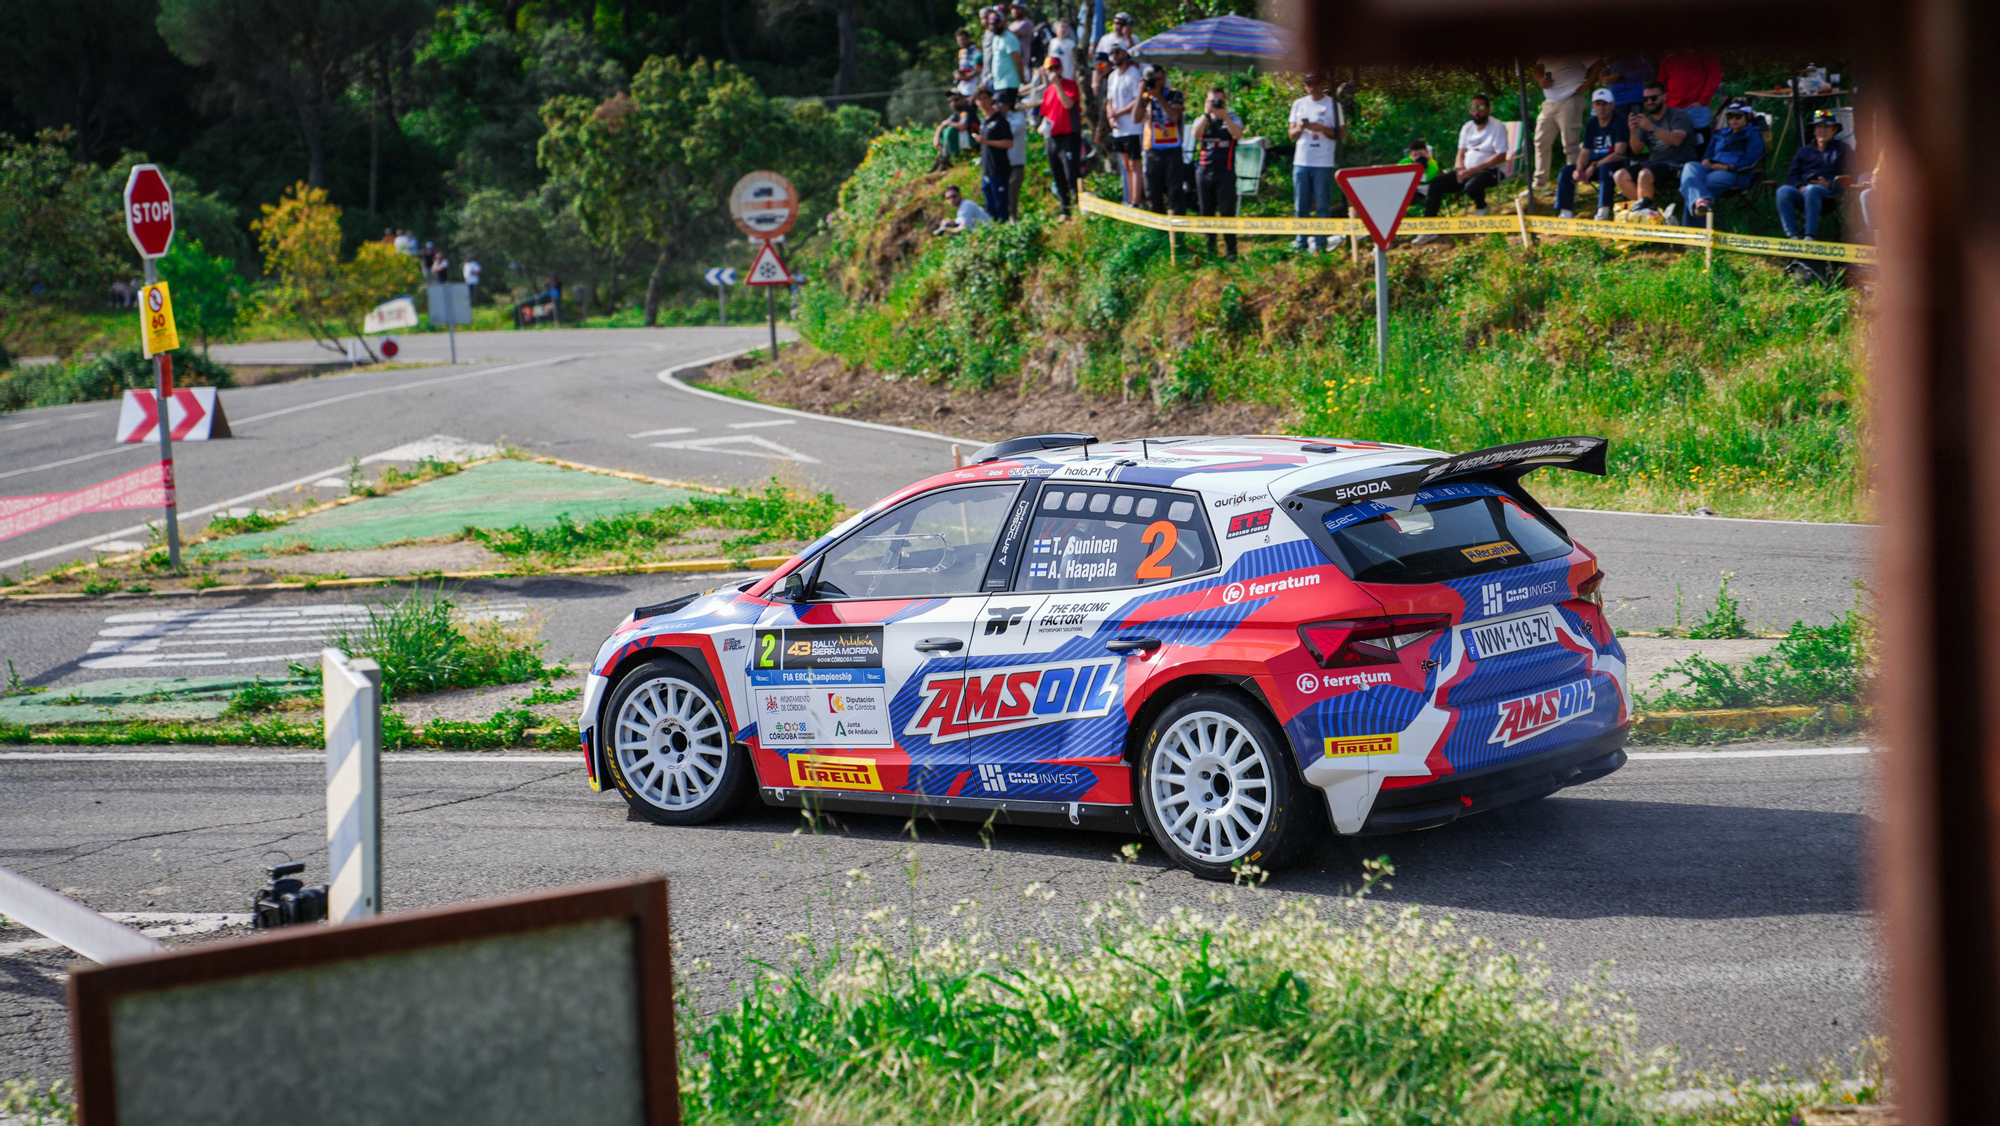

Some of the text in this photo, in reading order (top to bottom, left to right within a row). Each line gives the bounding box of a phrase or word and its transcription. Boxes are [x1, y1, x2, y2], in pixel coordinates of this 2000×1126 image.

[132, 201, 170, 223] STOP
[1292, 221, 1308, 230] ZONA
[1342, 222, 1360, 231] ZOA
[1419, 220, 1450, 230] PUBLICO
[1458, 218, 1511, 230] ZONA PUBLICO
[1575, 222, 1593, 232] ZONA
[1777, 241, 1846, 258] ZONA PUBLICO
[151, 313, 166, 329] 60
[1064, 467, 1101, 476] halo.P1
[1214, 491, 1268, 507] auriol sport
[1230, 508, 1273, 531] ETS
[1324, 513, 1358, 530] ERC
[1227, 525, 1268, 538] RACING FUELS
[1053, 536, 1118, 555] T. Suninen
[1134, 520, 1178, 579] 2
[1476, 544, 1509, 559] Recalvi
[1047, 559, 1118, 582] A. Haapala
[1249, 574, 1320, 596] ferratum
[1505, 581, 1557, 603] CM3 INVEST
[1048, 602, 1111, 614] THE RACING
[1040, 614, 1088, 626] FACTORY
[1475, 616, 1552, 655] WW-119-ZY
[760, 633, 776, 667] 2
[787, 640, 837, 656] 43 RALLY
[811, 646, 879, 656] SIERRA MORENA
[782, 672, 852, 682] FIA ERC Championship
[1323, 672, 1391, 687] ferratum
[780, 695, 810, 703] AYUNTAMIENTO
[846, 696, 875, 704] Diputación
[912, 662, 1115, 739] AMSOIL
[786, 703, 807, 711] CÓRDOBA
[1493, 679, 1595, 744] AMSOIL
[769, 732, 797, 740] CÓRDOBA
[1331, 737, 1393, 755] PIRELLI
[796, 760, 871, 785] PIRELLI
[1008, 772, 1079, 785] CM3 INVEST
